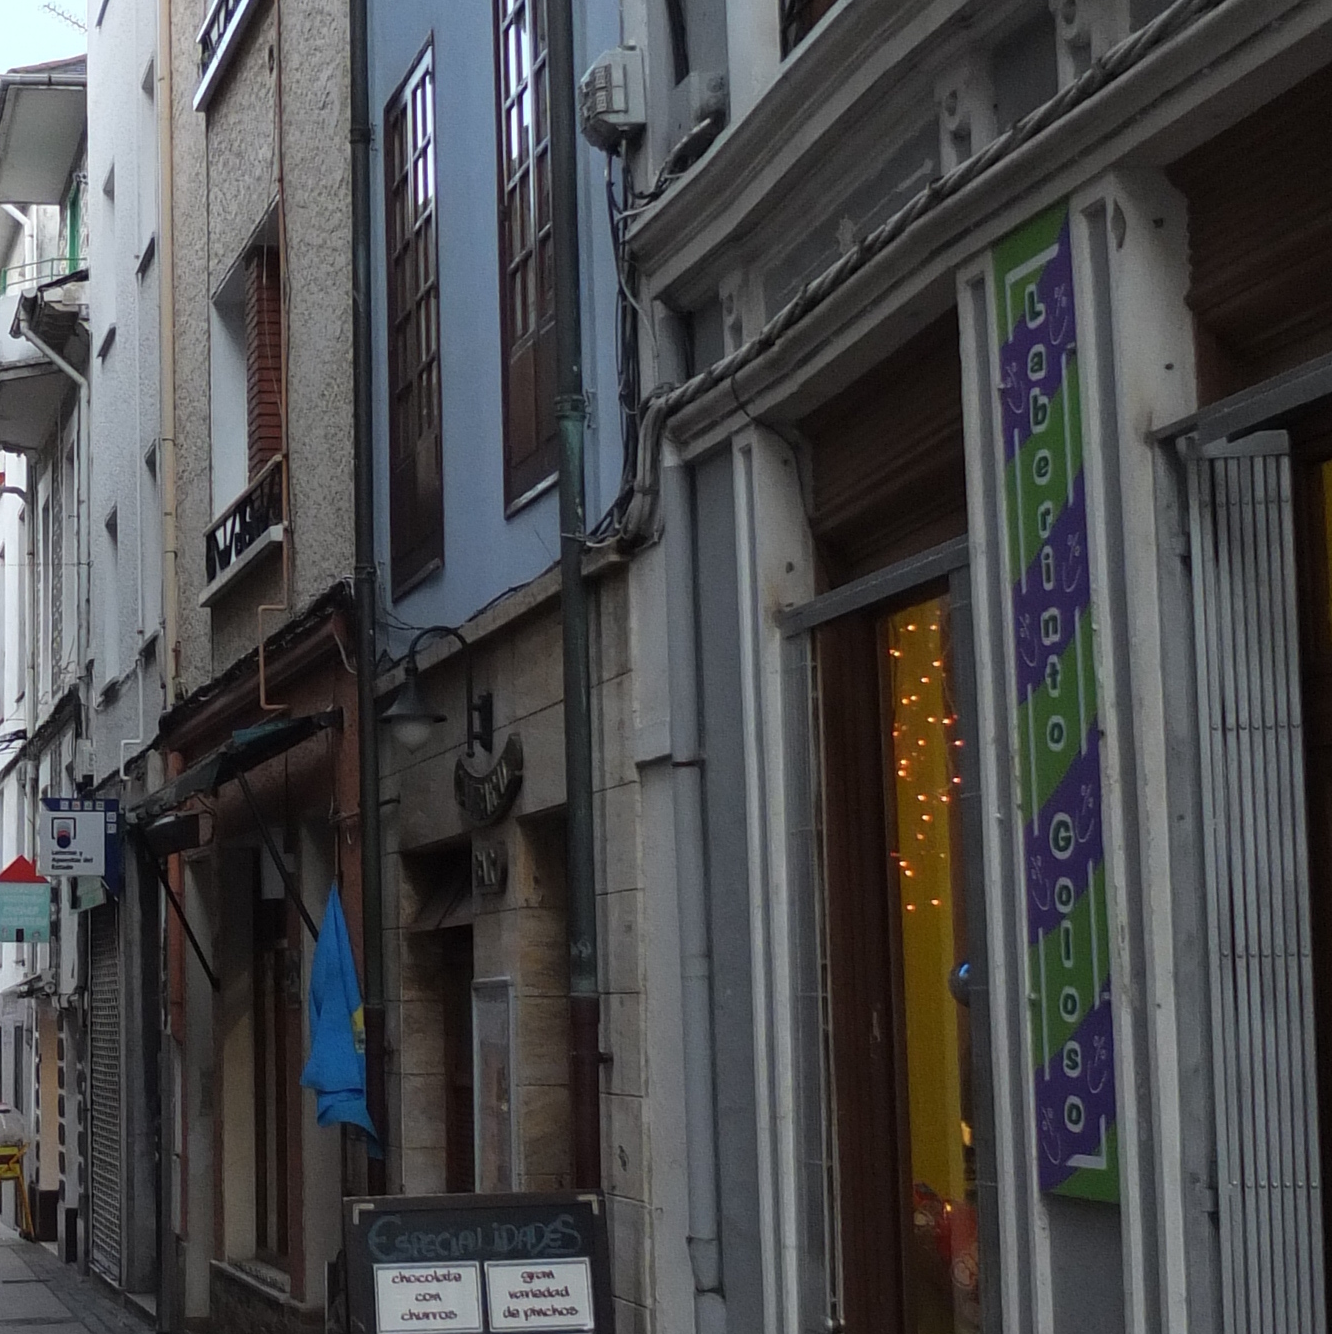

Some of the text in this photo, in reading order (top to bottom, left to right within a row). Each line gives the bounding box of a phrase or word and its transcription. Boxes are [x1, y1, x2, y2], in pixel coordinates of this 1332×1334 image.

[1024, 282, 1085, 1133] Laberinto Goloso
[392, 1270, 462, 1284] chocolate
[521, 1270, 555, 1283] gran
[415, 1293, 442, 1302] con
[508, 1286, 570, 1299] variedad
[401, 1309, 457, 1321] churros
[503, 1305, 578, 1321] de pinchos
